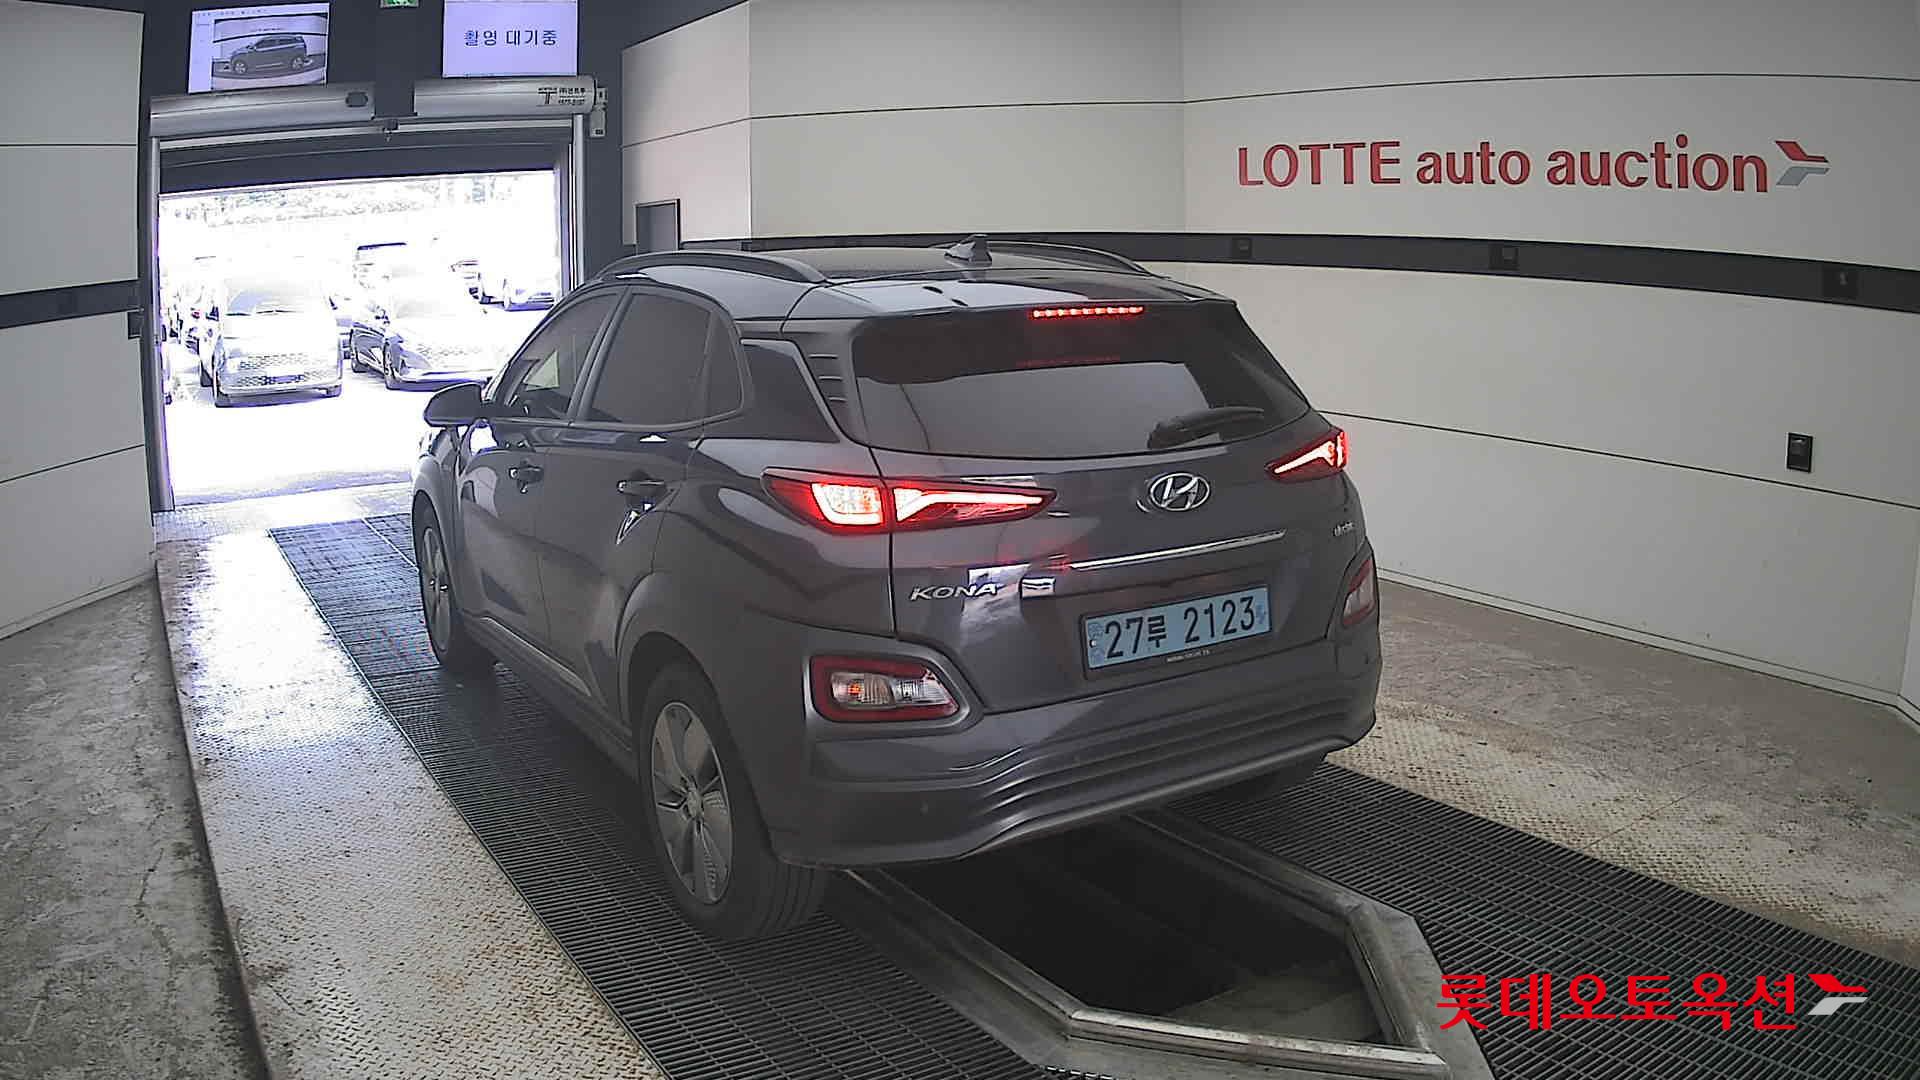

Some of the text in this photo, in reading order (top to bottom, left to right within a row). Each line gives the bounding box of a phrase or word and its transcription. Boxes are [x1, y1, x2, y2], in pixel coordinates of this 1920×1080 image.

[464, 29, 557, 47] 촬영 대기중
[1237, 134, 1768, 193] LOTTE auto auction
[910, 583, 998, 601] KONA
[1105, 596, 1256, 659] 27루 2123
